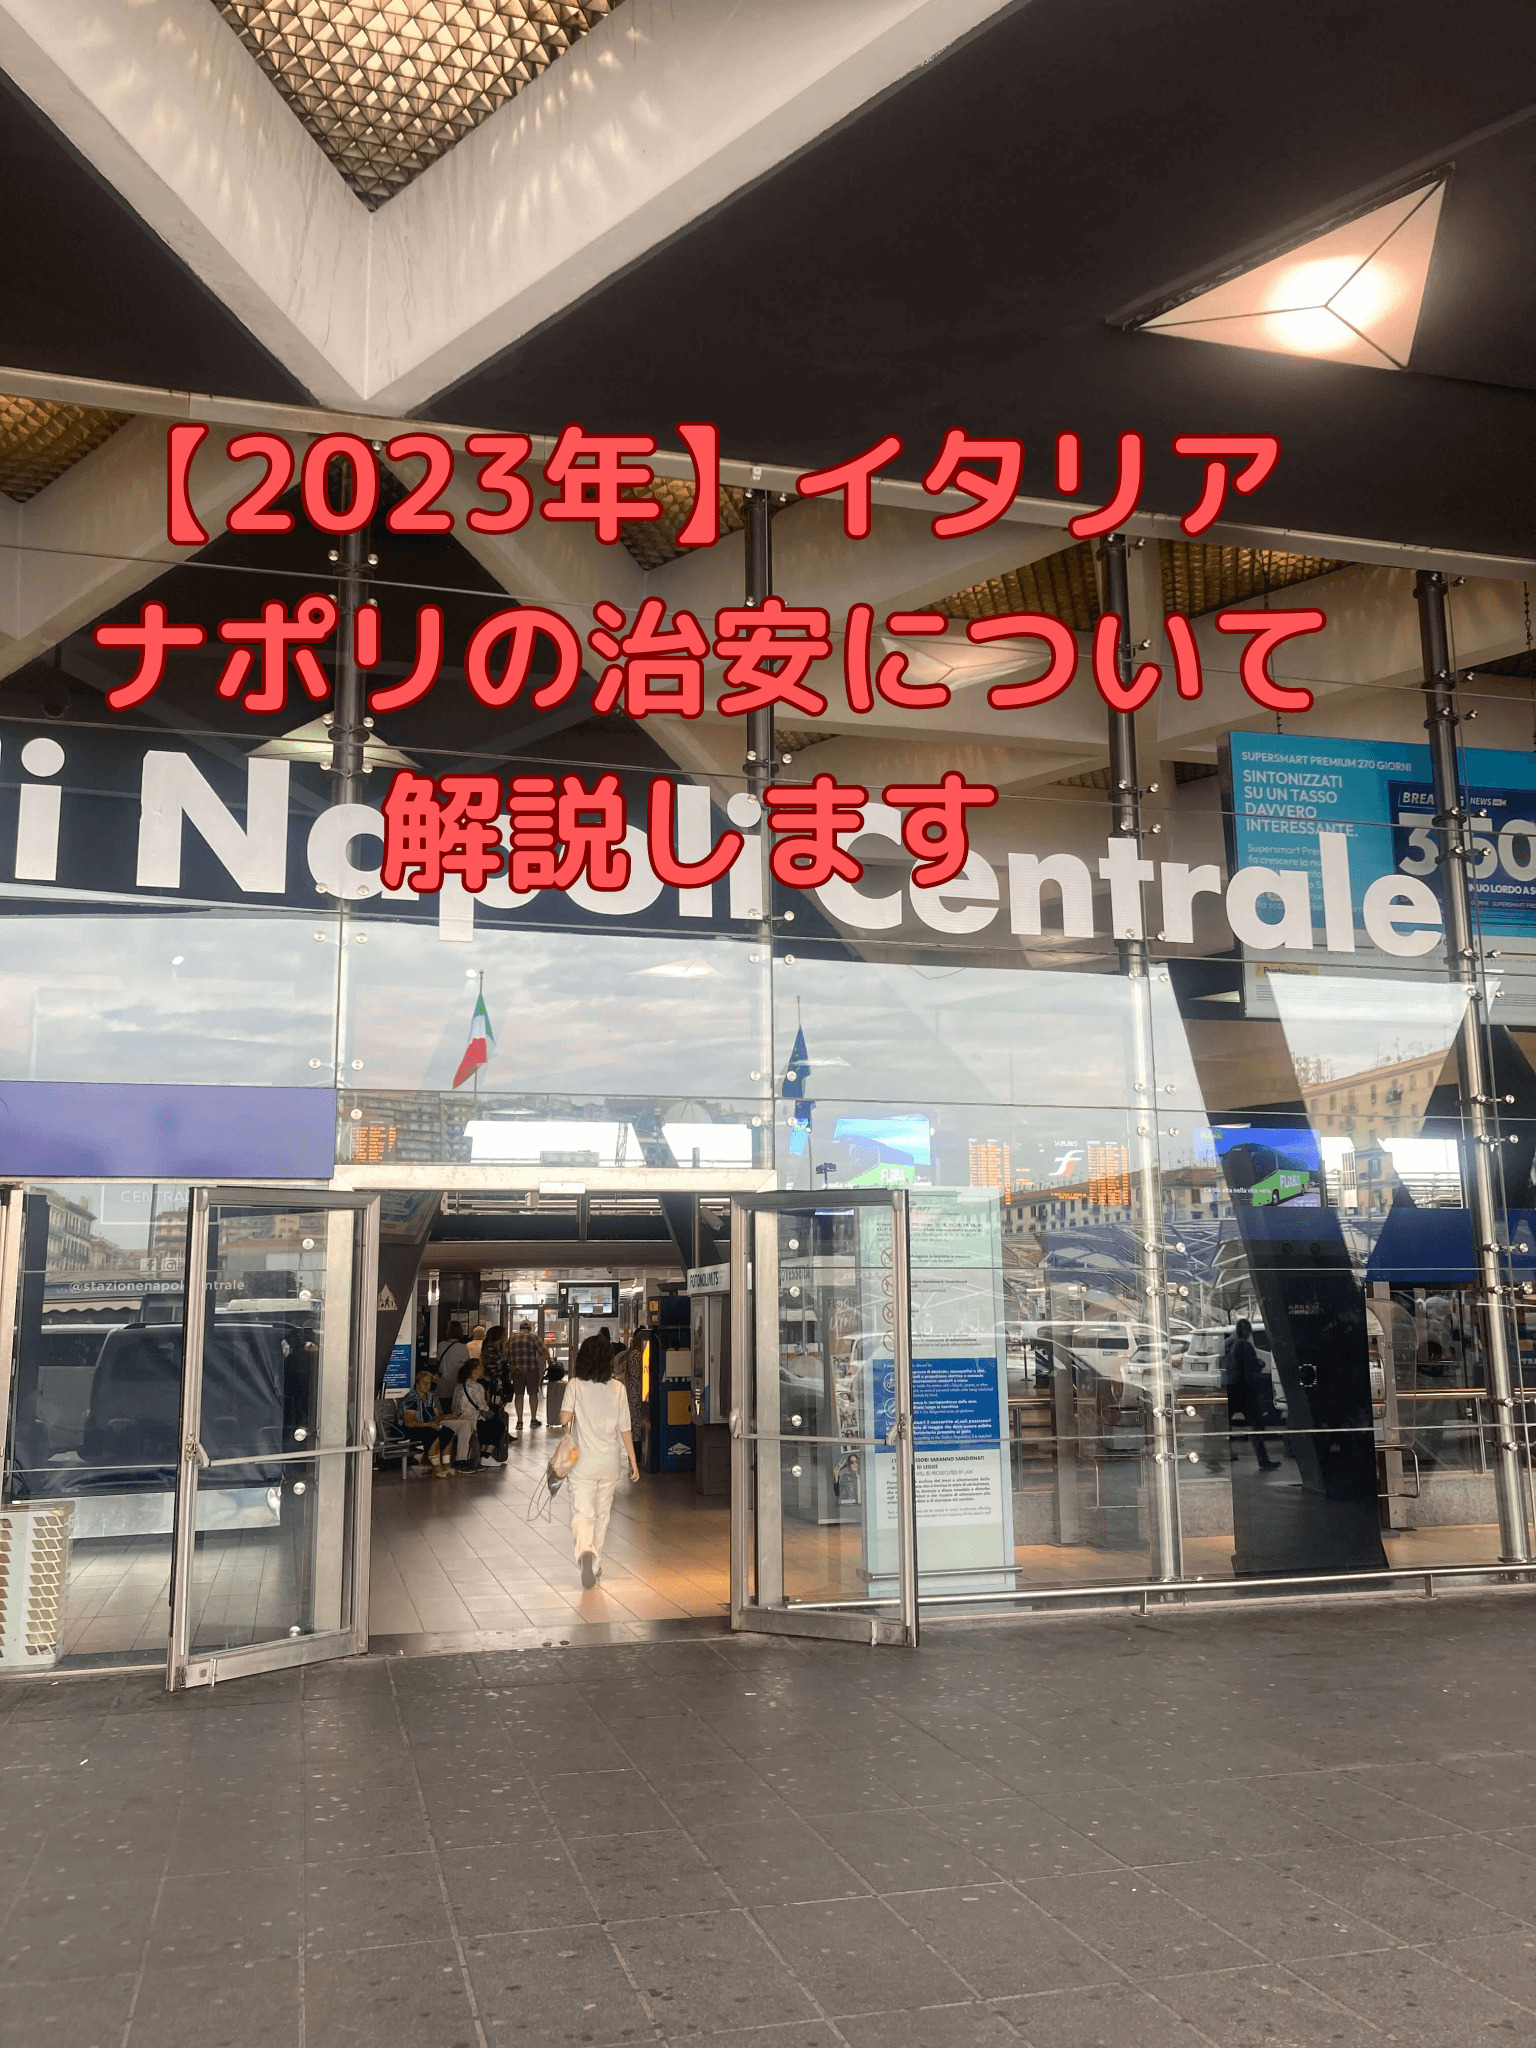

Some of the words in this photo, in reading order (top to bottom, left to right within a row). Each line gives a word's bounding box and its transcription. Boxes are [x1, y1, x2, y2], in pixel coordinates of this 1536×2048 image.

[1241, 751, 1309, 766] SUPERSMART
[1310, 755, 1357, 768] PREMIUM
[1357, 759, 1376, 769] 270
[1376, 761, 1412, 772] GIORNI
[1243, 769, 1343, 789] SINTONIZZATI
[1243, 785, 1263, 800] SU
[1266, 788, 1288, 801] UN
[1290, 788, 1338, 804] TASSO
[1469, 796, 1492, 806] NEWS
[1244, 802, 1317, 819] DAVVERO
[1246, 818, 1359, 838] INTERESSANTE.
[1247, 842, 1300, 855] Supersmart
[812, 802, 1443, 957] Centrale
[1490, 884, 1522, 895] LORDO
